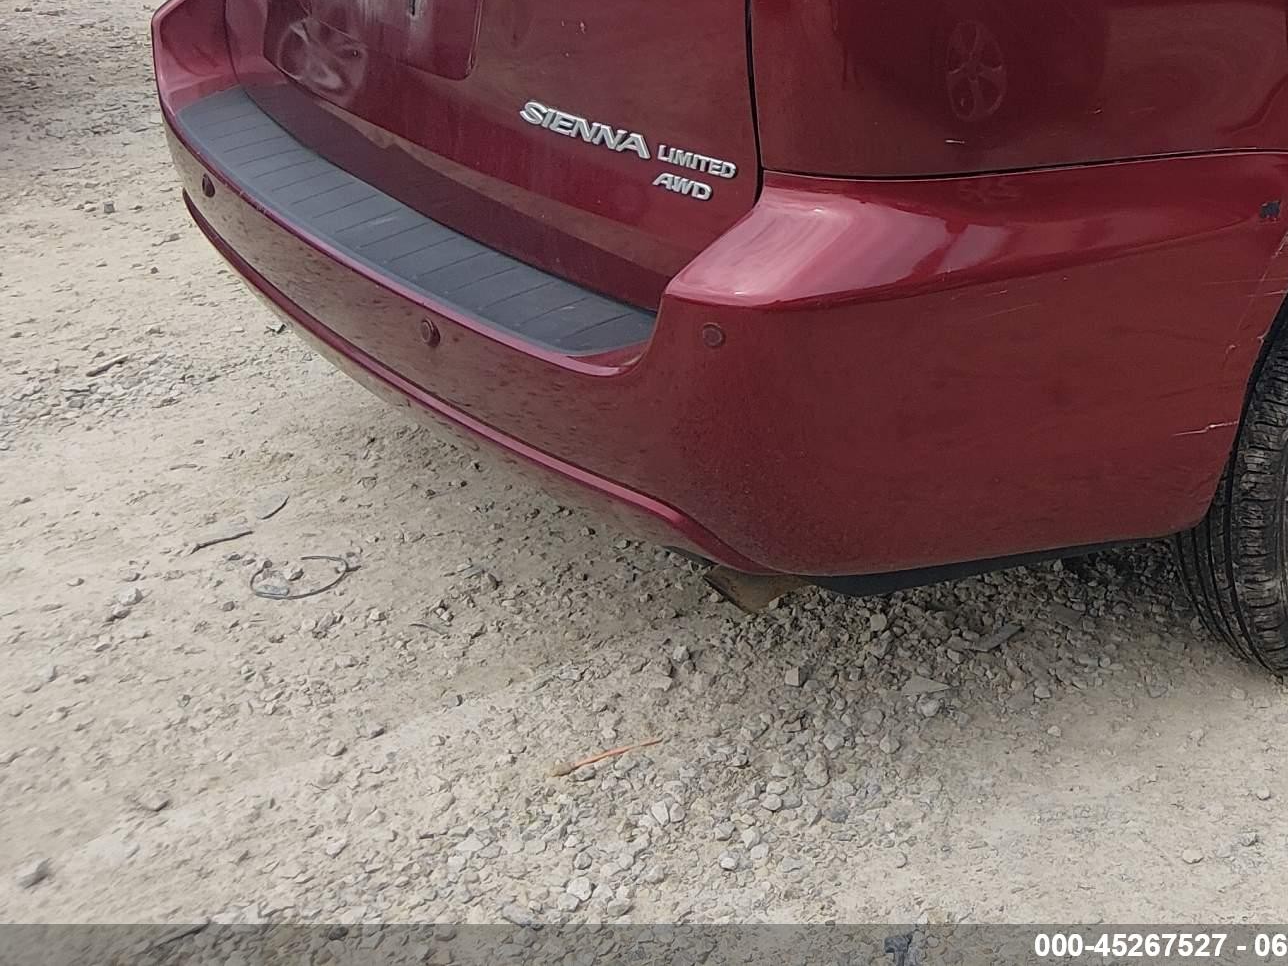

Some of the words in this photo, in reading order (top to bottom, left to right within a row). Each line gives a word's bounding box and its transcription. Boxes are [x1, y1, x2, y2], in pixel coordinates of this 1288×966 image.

[519, 101, 651, 160] SIENNA
[656, 144, 737, 179] LIMITED
[652, 172, 713, 201] AWD
